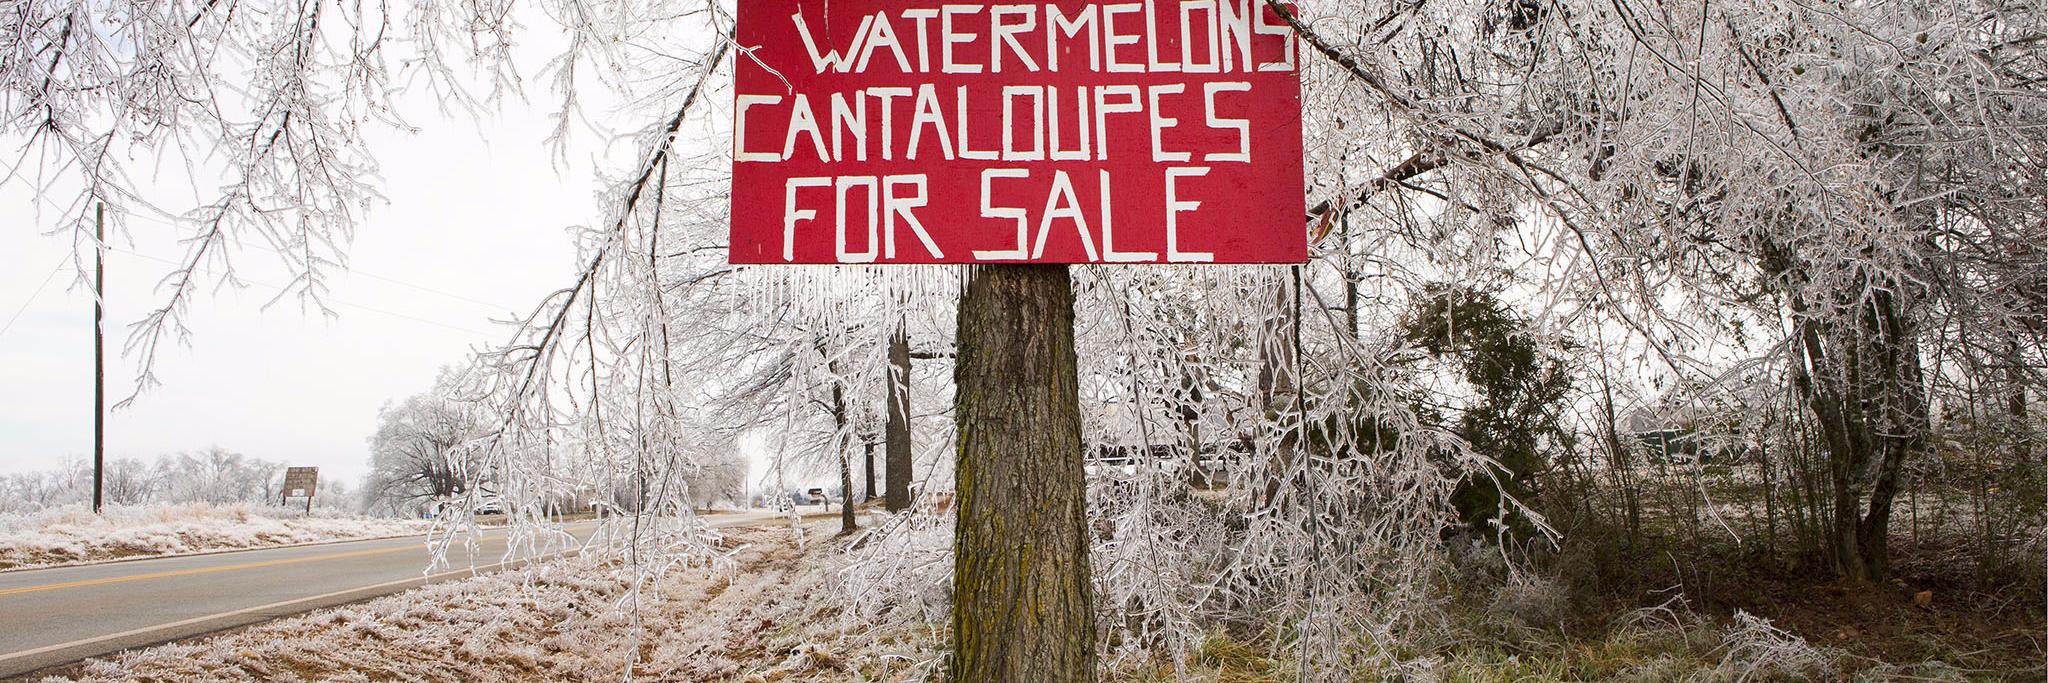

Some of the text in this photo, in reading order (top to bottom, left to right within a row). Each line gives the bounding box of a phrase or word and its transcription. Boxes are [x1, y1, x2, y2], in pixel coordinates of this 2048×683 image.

[792, 0, 1295, 74] WATERMELONS
[734, 82, 1252, 163] CANTALOUPES
[783, 167, 1214, 261] FOR SALE
